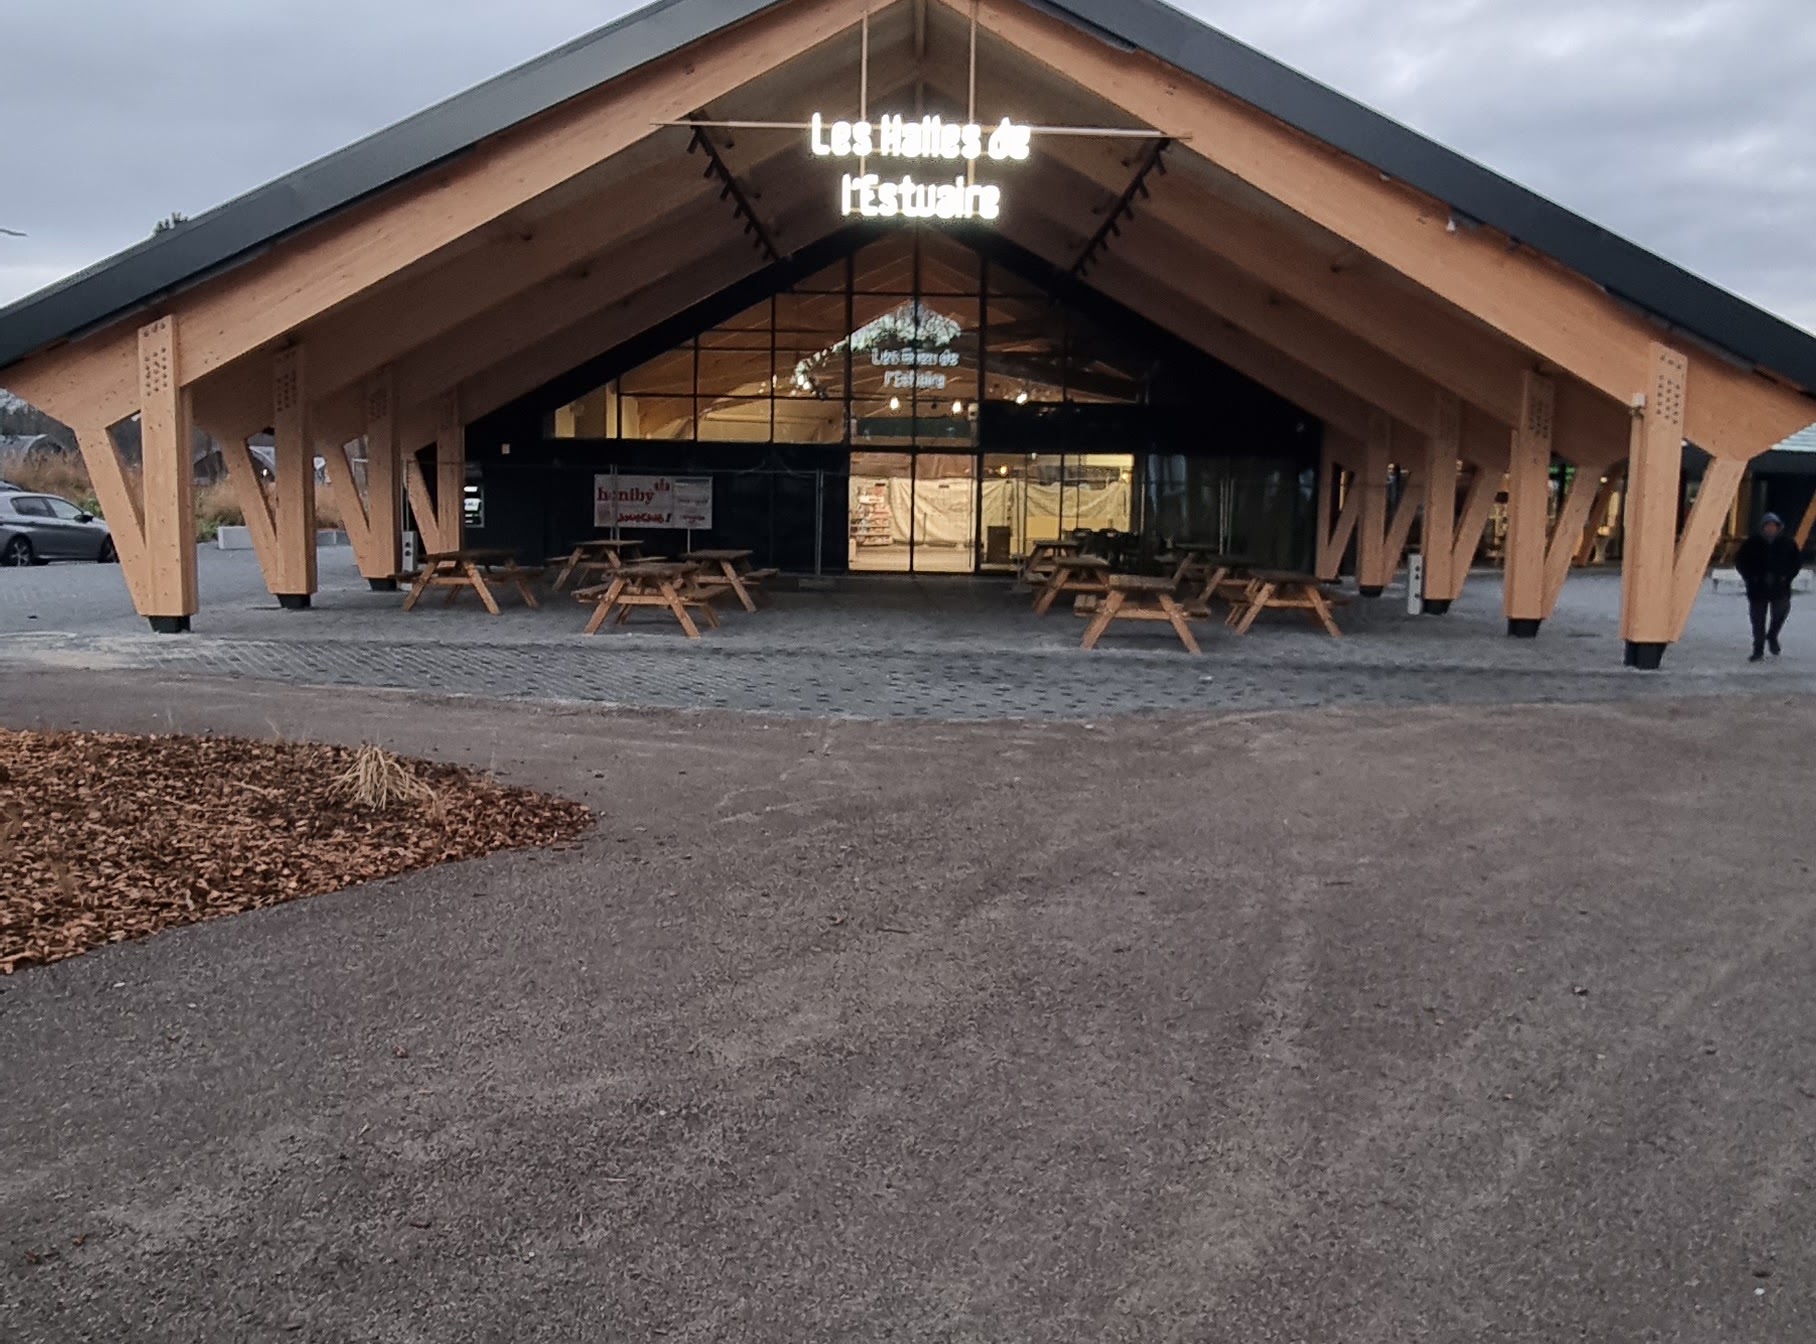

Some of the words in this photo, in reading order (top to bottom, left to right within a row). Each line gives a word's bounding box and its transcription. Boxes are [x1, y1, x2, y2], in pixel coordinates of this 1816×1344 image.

[812, 112, 872, 156] Les
[881, 114, 981, 159] Halles
[988, 117, 1031, 159] de
[842, 174, 1000, 219] l'Estuaire
